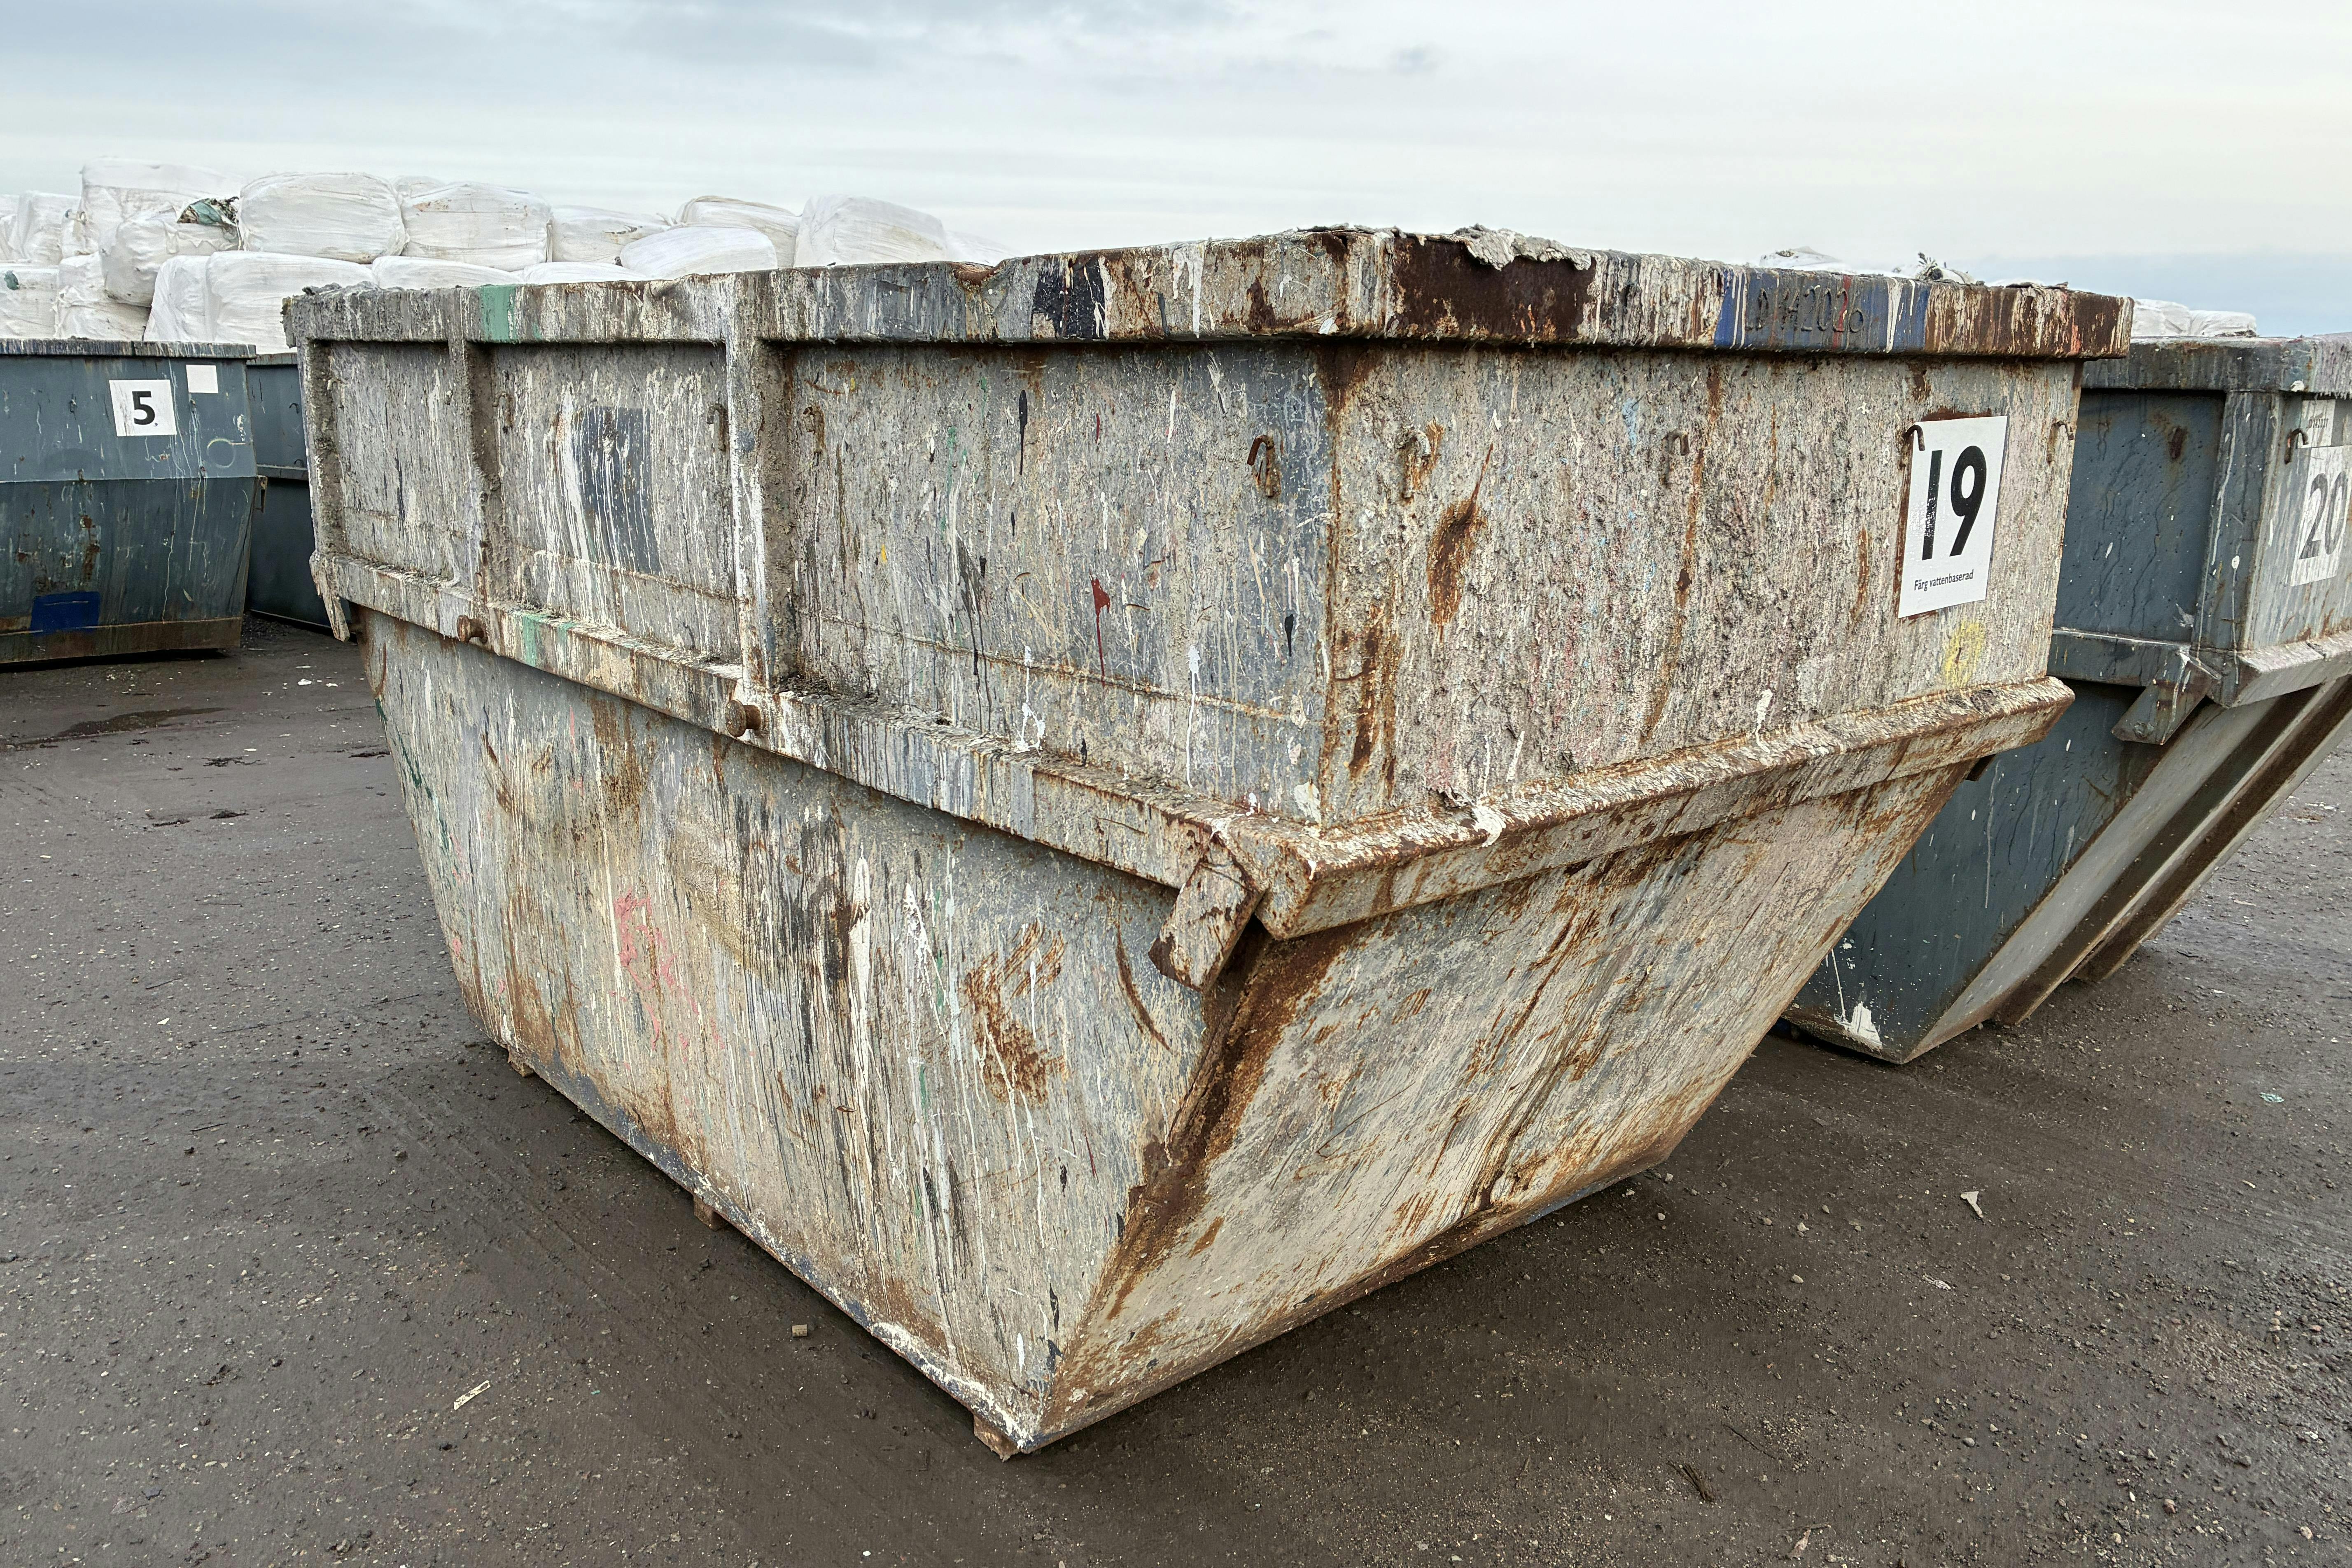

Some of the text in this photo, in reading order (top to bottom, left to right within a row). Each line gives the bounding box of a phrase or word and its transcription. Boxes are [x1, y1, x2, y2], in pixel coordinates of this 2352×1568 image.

[132, 391, 155, 425] 5
[1922, 445, 1987, 560] 19
[2298, 471, 2348, 560] 20
[1914, 569, 1974, 592] Färg vattenbaserad
